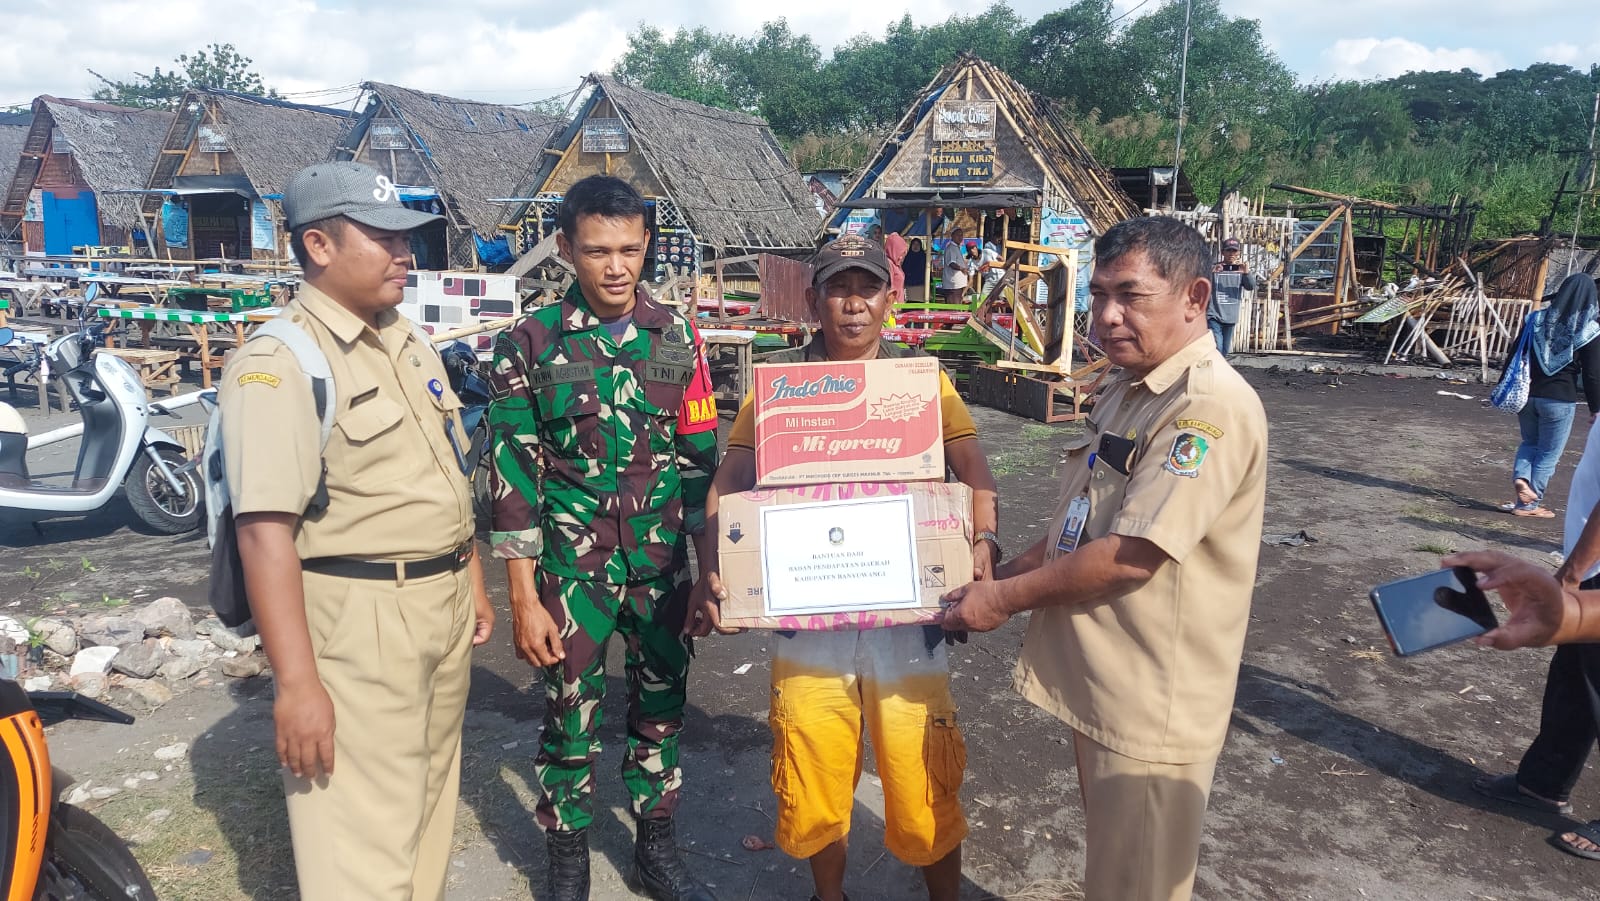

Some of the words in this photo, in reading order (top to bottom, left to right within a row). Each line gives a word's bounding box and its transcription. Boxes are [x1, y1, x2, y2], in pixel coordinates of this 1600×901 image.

[651, 367, 675, 380] TNI
[761, 374, 857, 406] Indomie
[785, 417, 799, 428] Mi
[801, 416, 836, 427] Instan
[792, 435, 827, 453] Mi
[827, 437, 903, 456] goreng
[812, 552, 845, 560] BANTUAN
[788, 564, 812, 573] BADAN
[813, 562, 860, 571] PENDAPATAN
[860, 560, 890, 568] DAERAH
[794, 574, 836, 583] KABUPATEN
[837, 571, 886, 580] BANYUWANGI
